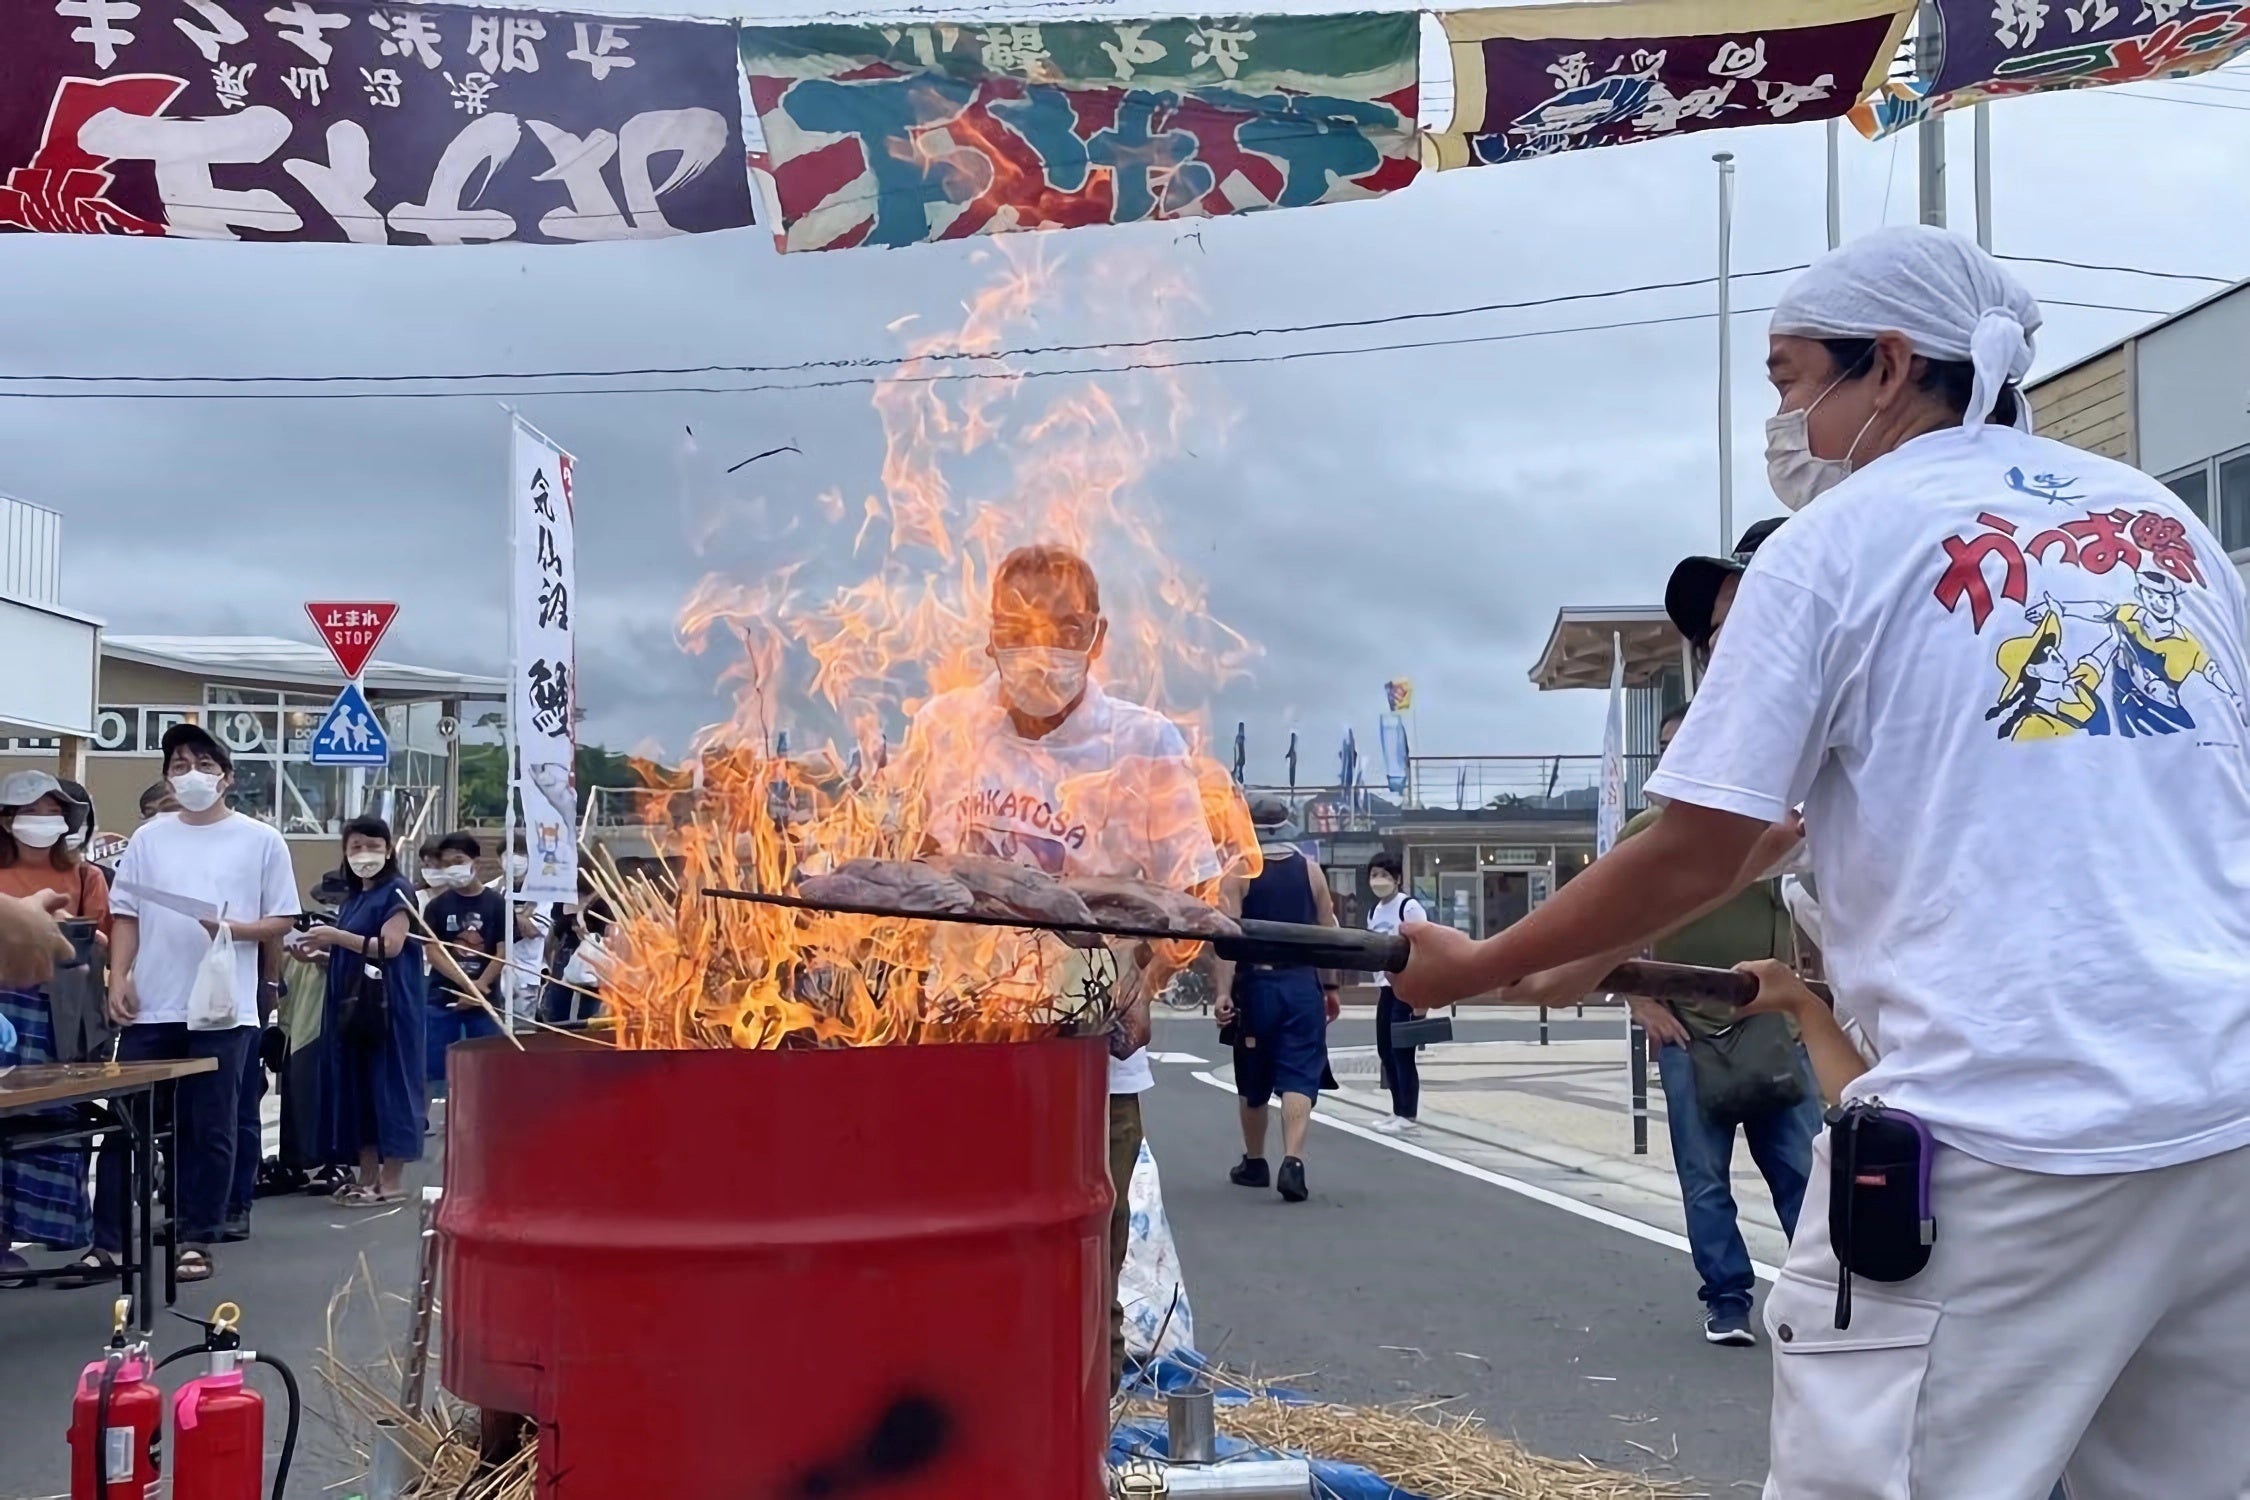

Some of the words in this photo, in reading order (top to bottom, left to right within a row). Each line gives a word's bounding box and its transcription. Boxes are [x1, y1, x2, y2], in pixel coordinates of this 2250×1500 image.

[529, 466, 568, 631] 気仙沼
[324, 609, 381, 627] 止まれ
[334, 630, 373, 645] STOP
